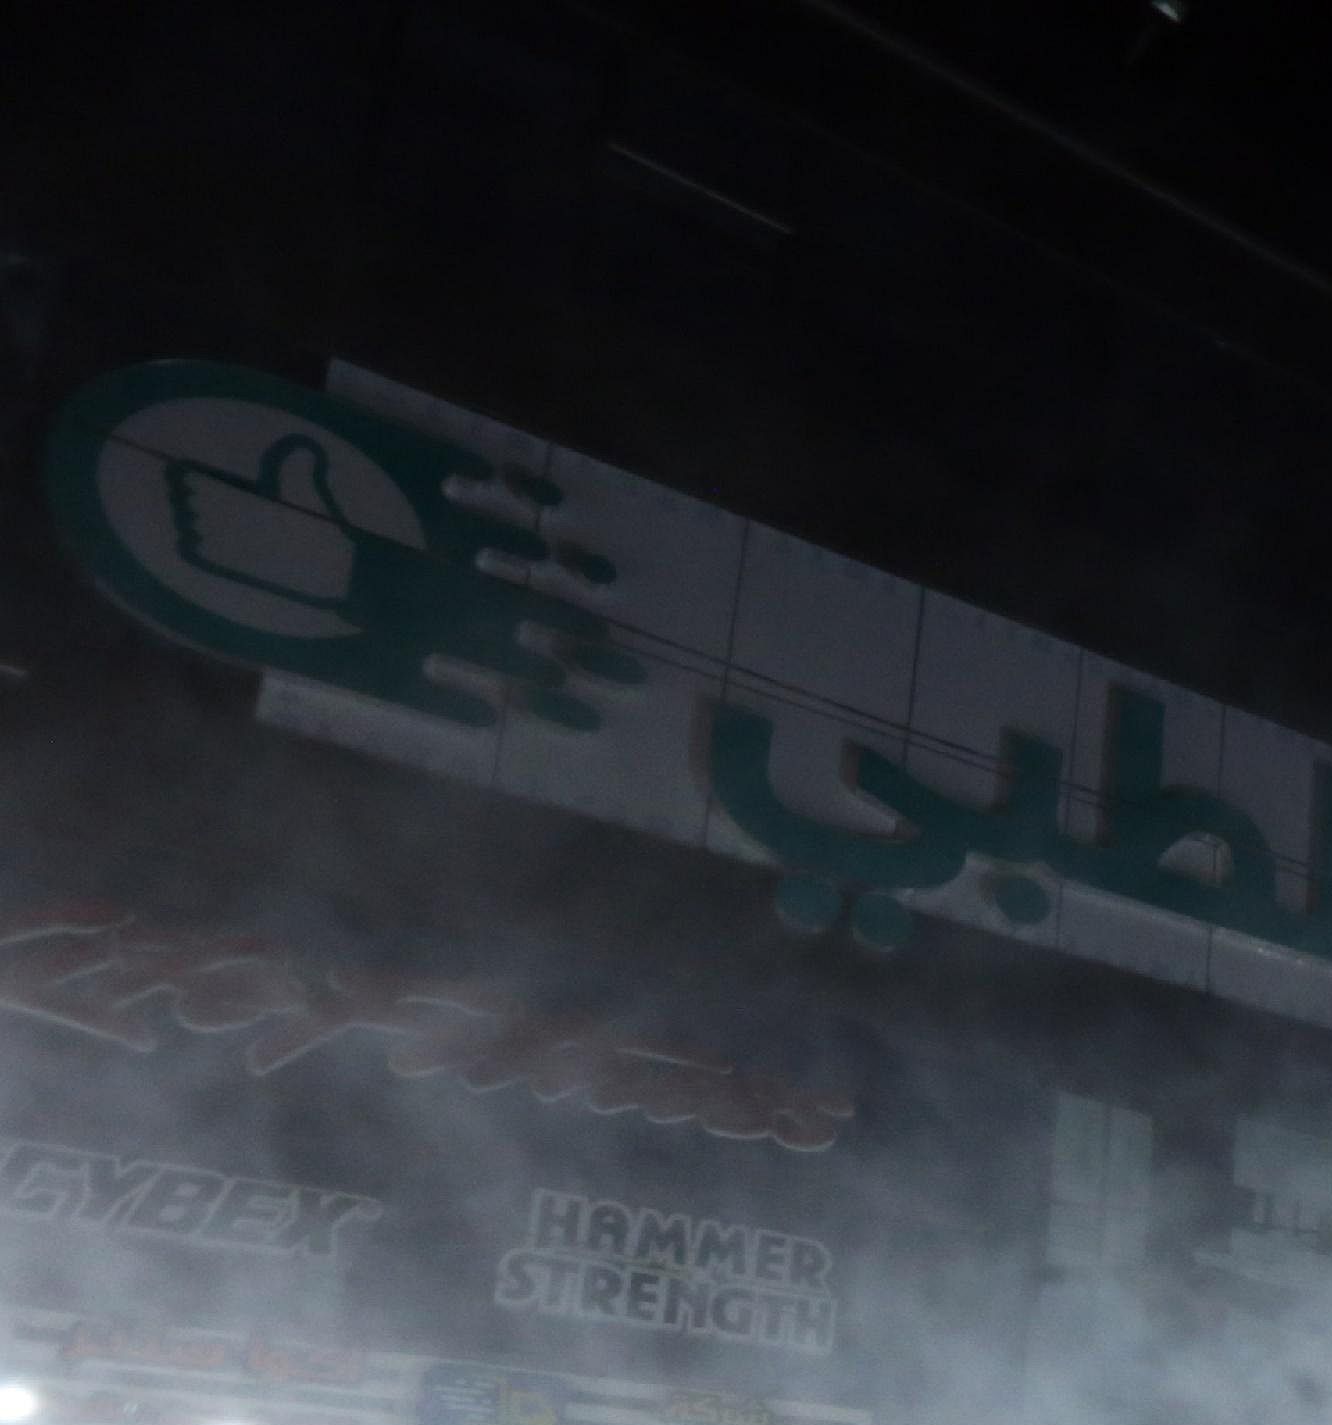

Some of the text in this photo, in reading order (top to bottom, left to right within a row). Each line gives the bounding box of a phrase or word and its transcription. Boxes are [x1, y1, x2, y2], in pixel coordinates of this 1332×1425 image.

[3, 1143, 382, 1257] CYBEX
[527, 1188, 838, 1291] HAMMER
[496, 1246, 838, 1355] STRENGTH
